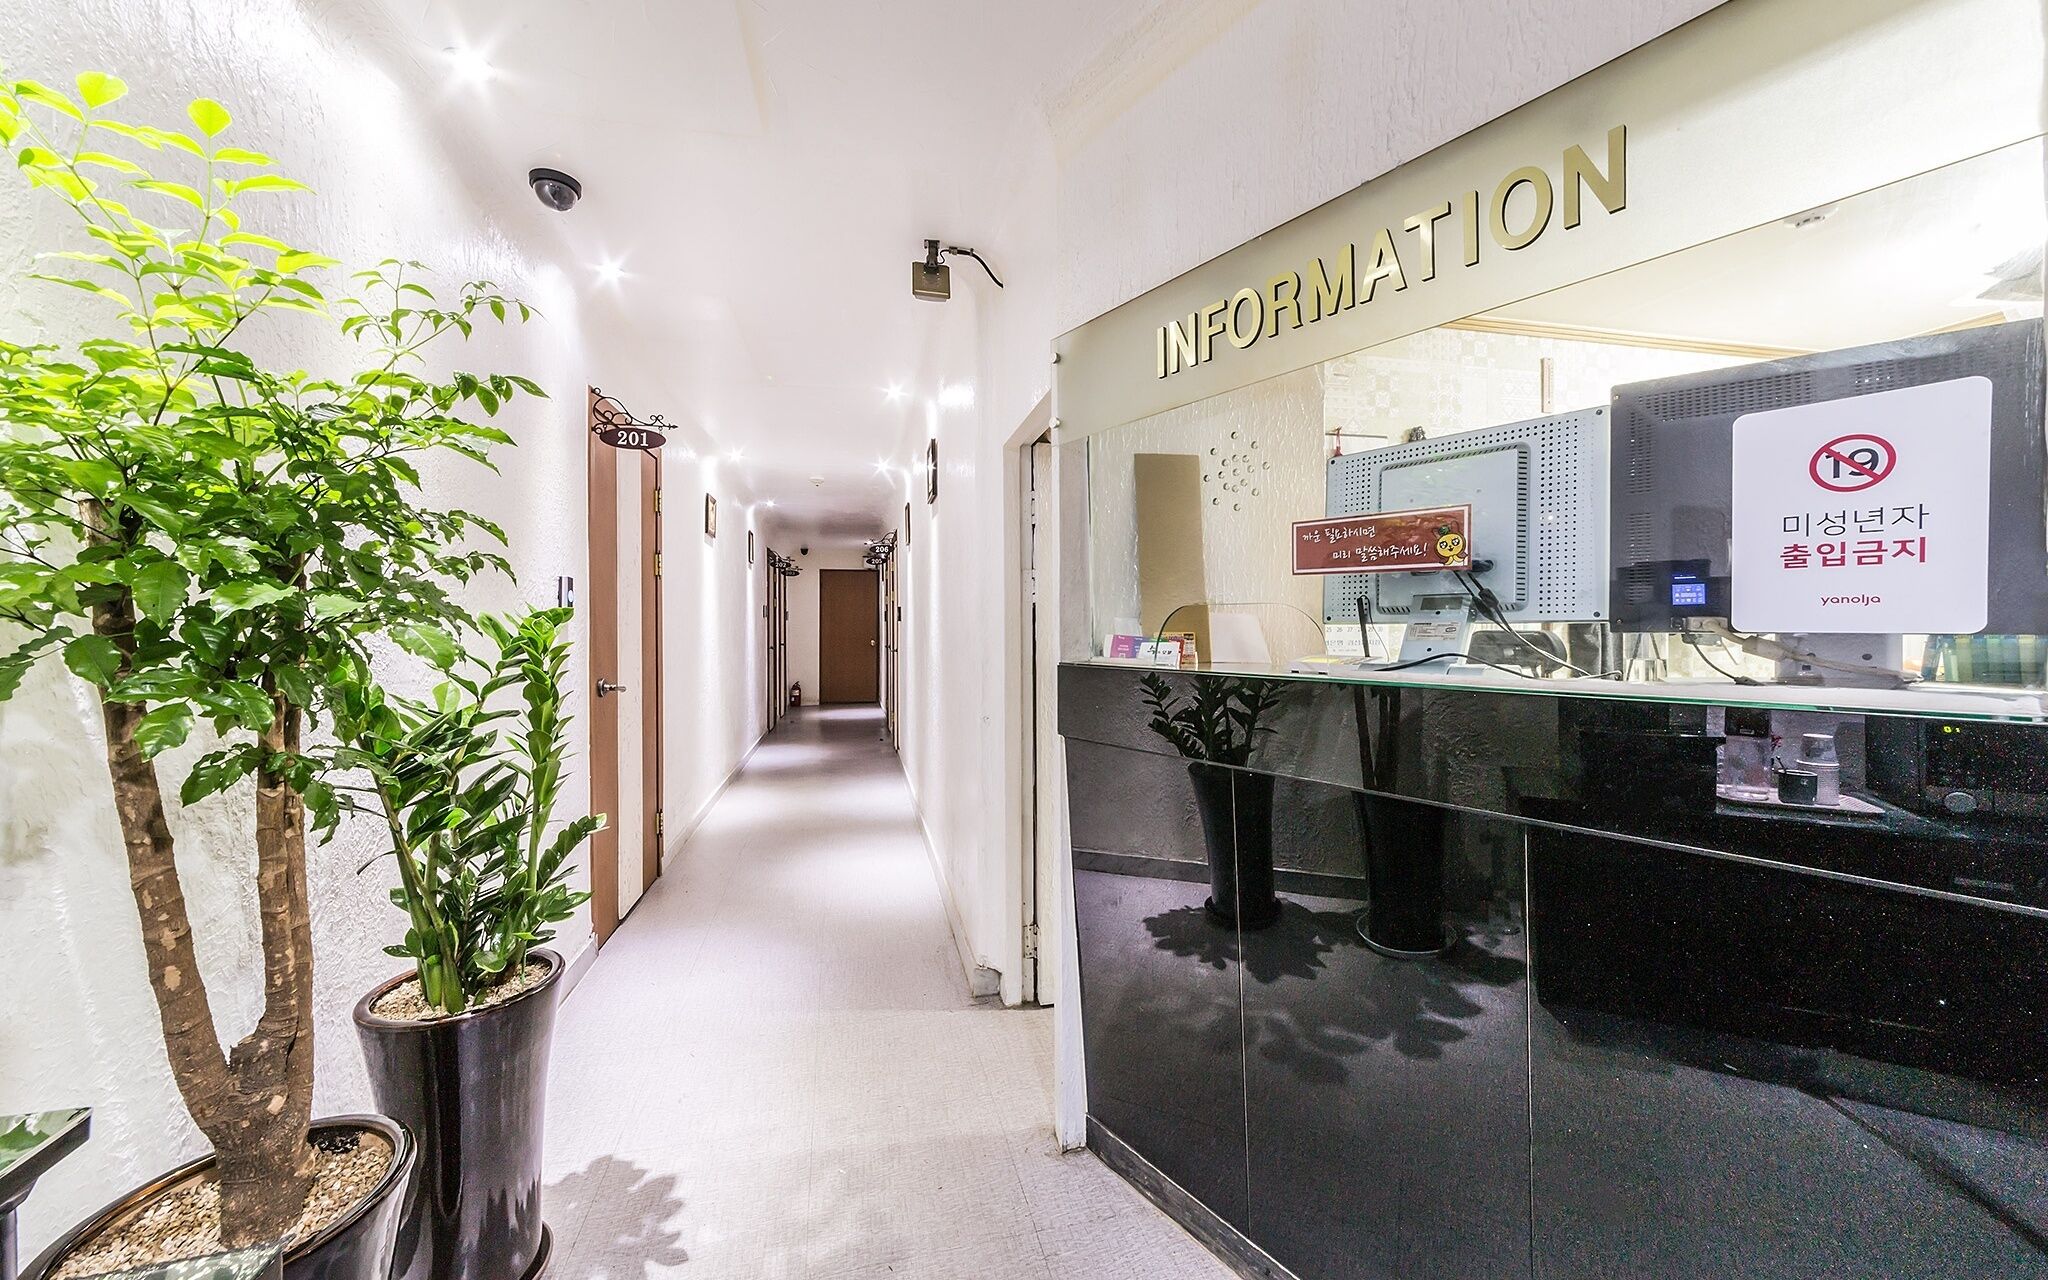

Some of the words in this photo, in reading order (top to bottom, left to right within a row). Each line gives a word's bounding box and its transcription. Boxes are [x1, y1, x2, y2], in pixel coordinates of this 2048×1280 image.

[1157, 125, 1626, 378] INFORMATION
[617, 431, 649, 447] 201
[1825, 448, 1880, 478] 19
[1783, 503, 1930, 537] 미성년자
[1325, 526, 1376, 544] 필요하시면
[1332, 550, 1350, 559] 미리
[1355, 543, 1428, 562] 말씀해주세요!
[1780, 536, 1926, 569] 출입금지
[1820, 594, 1881, 606] yanolja
